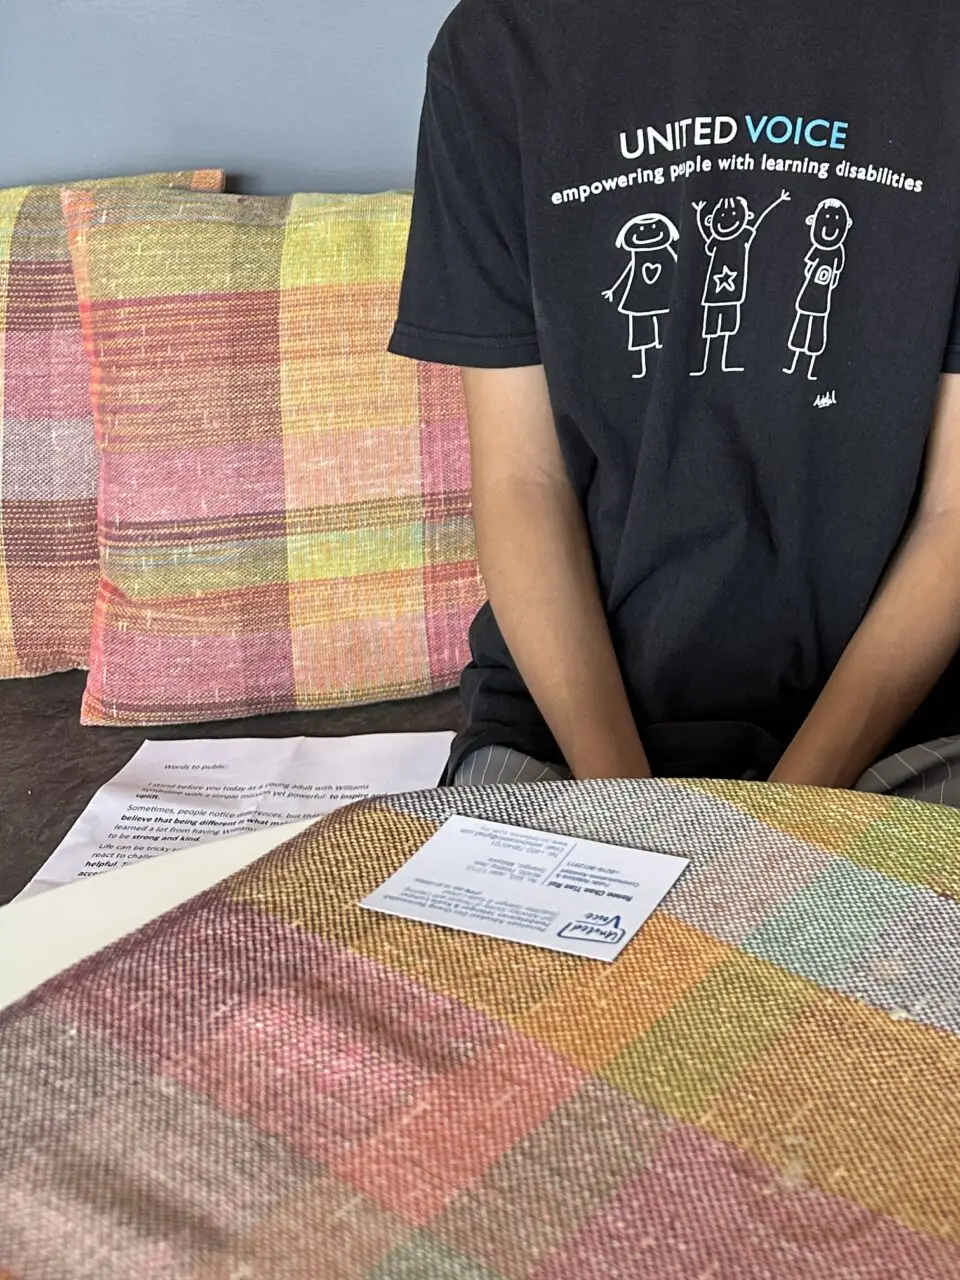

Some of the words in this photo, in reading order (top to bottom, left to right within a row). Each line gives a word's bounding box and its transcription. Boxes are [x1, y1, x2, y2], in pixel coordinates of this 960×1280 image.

[620, 115, 738, 159] UNITED
[745, 115, 848, 150] VOICE
[551, 167, 665, 205] empowering
[718, 154, 754, 170] with
[761, 153, 830, 179] learning
[836, 160, 923, 192] disabilities
[127, 804, 176, 815] Sometimes,
[177, 808, 207, 817] people
[209, 810, 236, 818] notice
[121, 814, 153, 823] believe
[154, 816, 173, 824] that
[173, 818, 198, 826] being
[199, 818, 237, 827] different
[114, 823, 147, 832] learned
[168, 826, 190, 834] from
[192, 826, 221, 835] having
[146, 845, 171, 853] tricky
[564, 884, 582, 892] Tian
[583, 888, 606, 896] Chan
